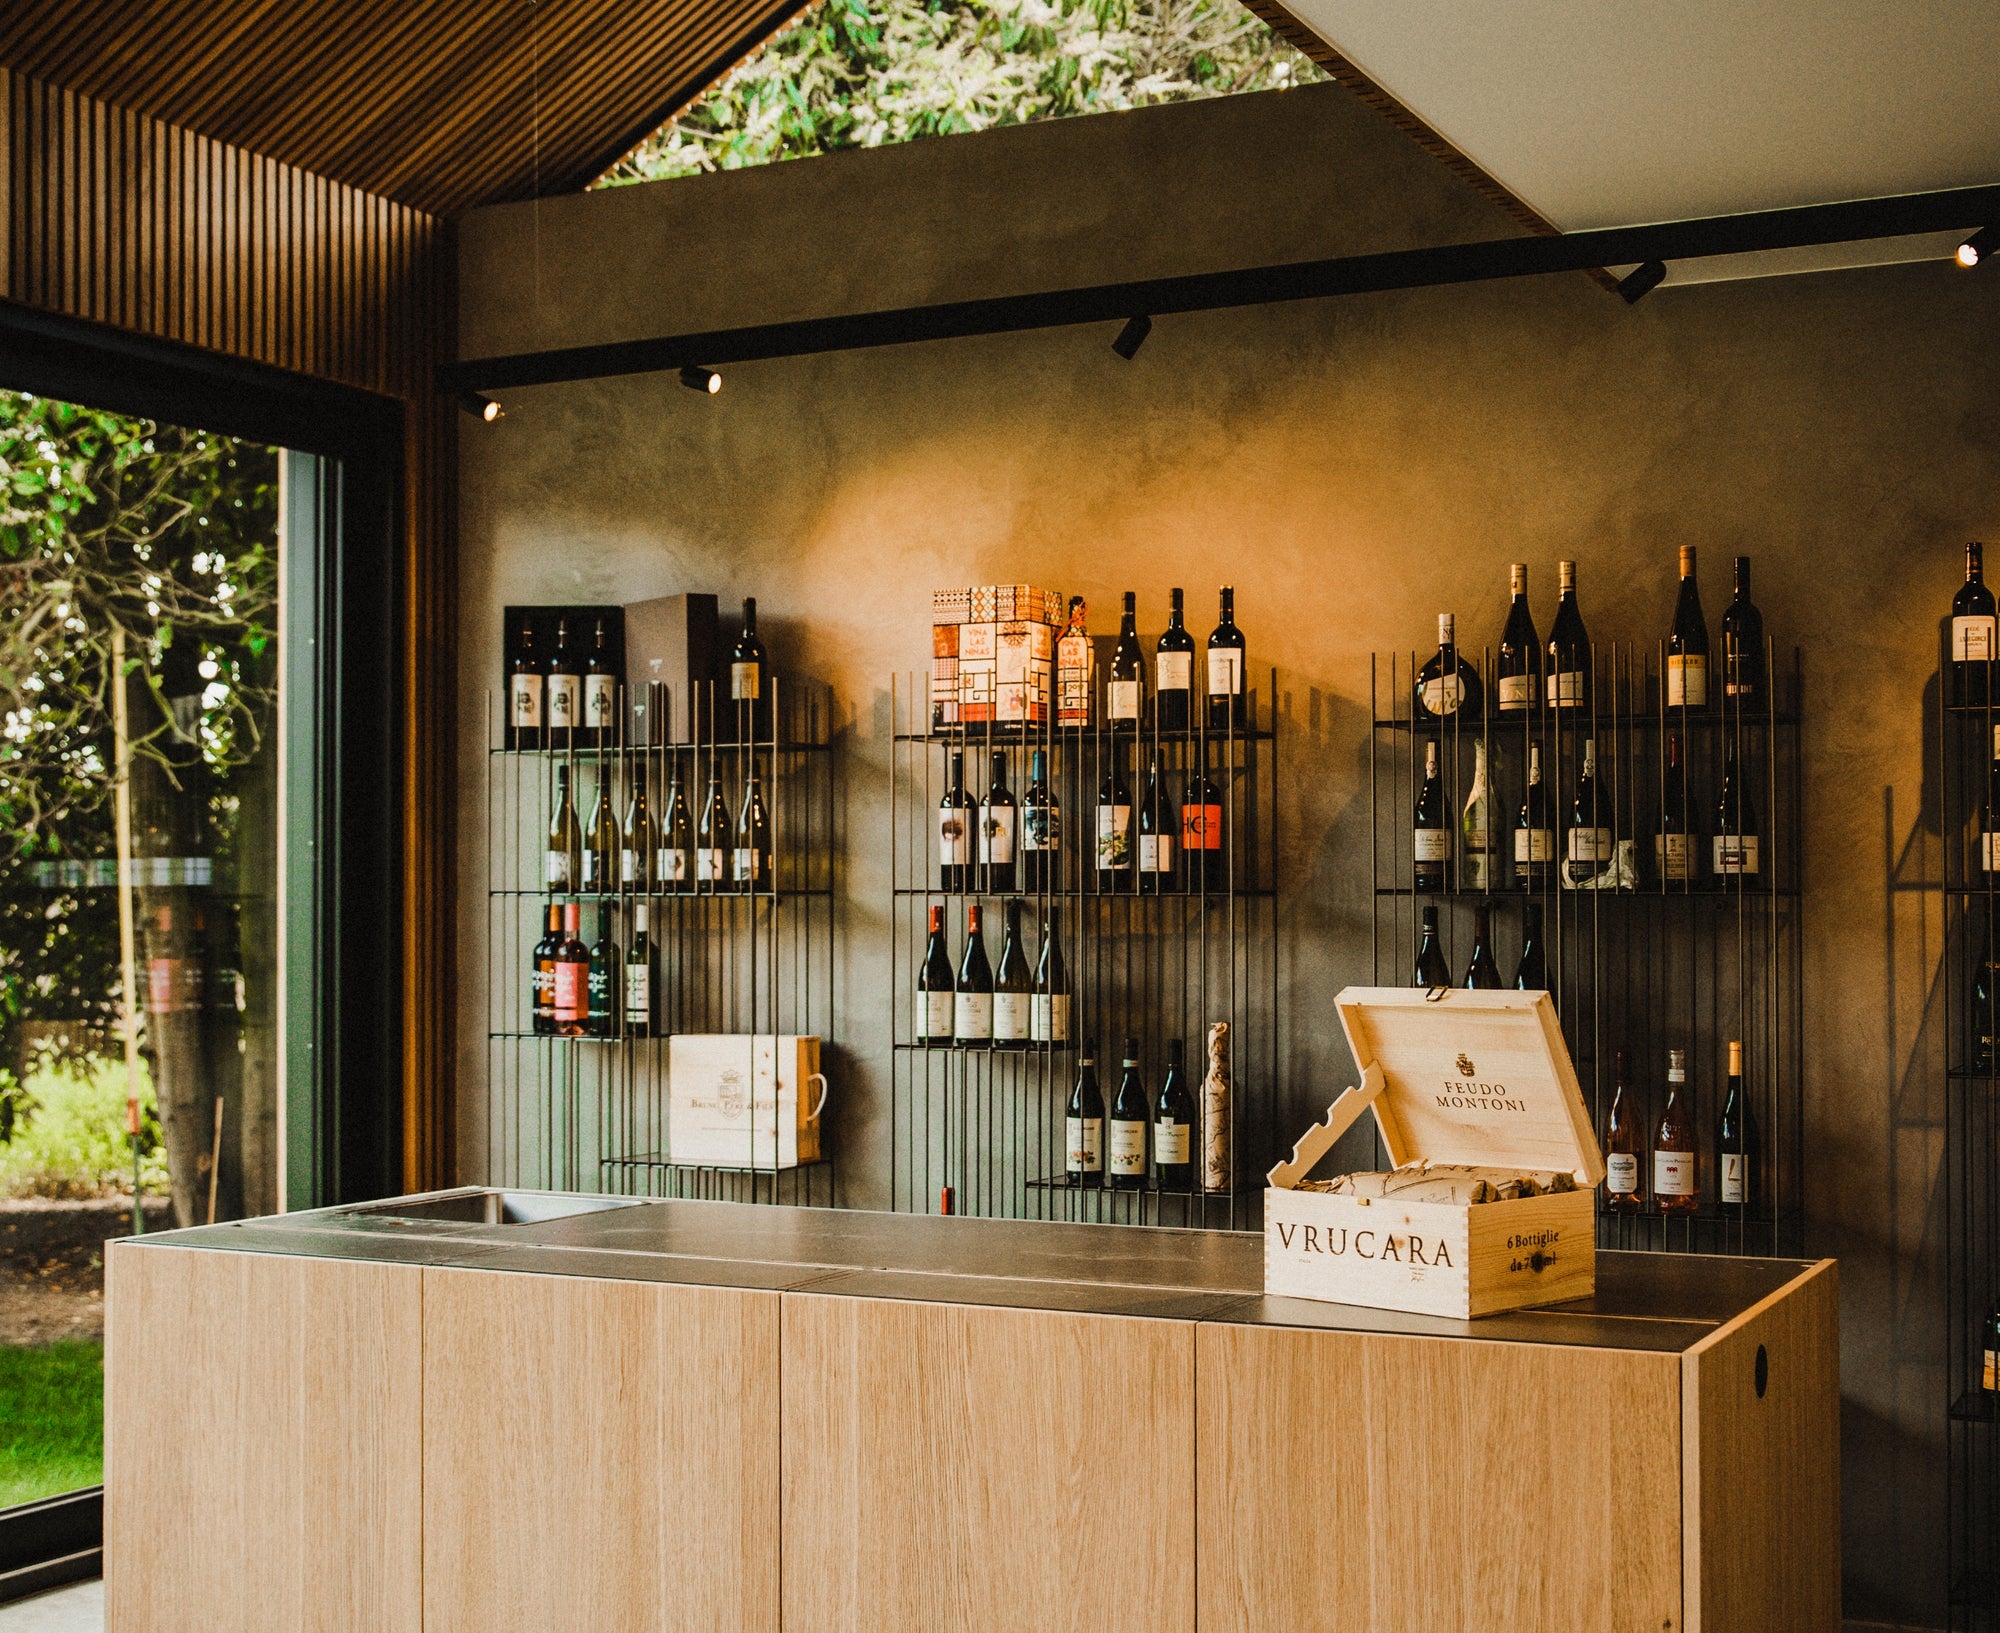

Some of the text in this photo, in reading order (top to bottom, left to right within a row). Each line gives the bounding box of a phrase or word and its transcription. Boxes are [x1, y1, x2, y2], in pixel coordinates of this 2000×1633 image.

[1062, 647, 1078, 656] LAS
[1444, 1082, 1506, 1096] FEUDO
[1436, 1096, 1526, 1112] MONTONI
[1276, 1222, 1454, 1268] VRUCARA
[1507, 1229, 1559, 1249] 6 Bottiglie
[1510, 1258, 1522, 1272] da
[1544, 1252, 1556, 1267] ml
